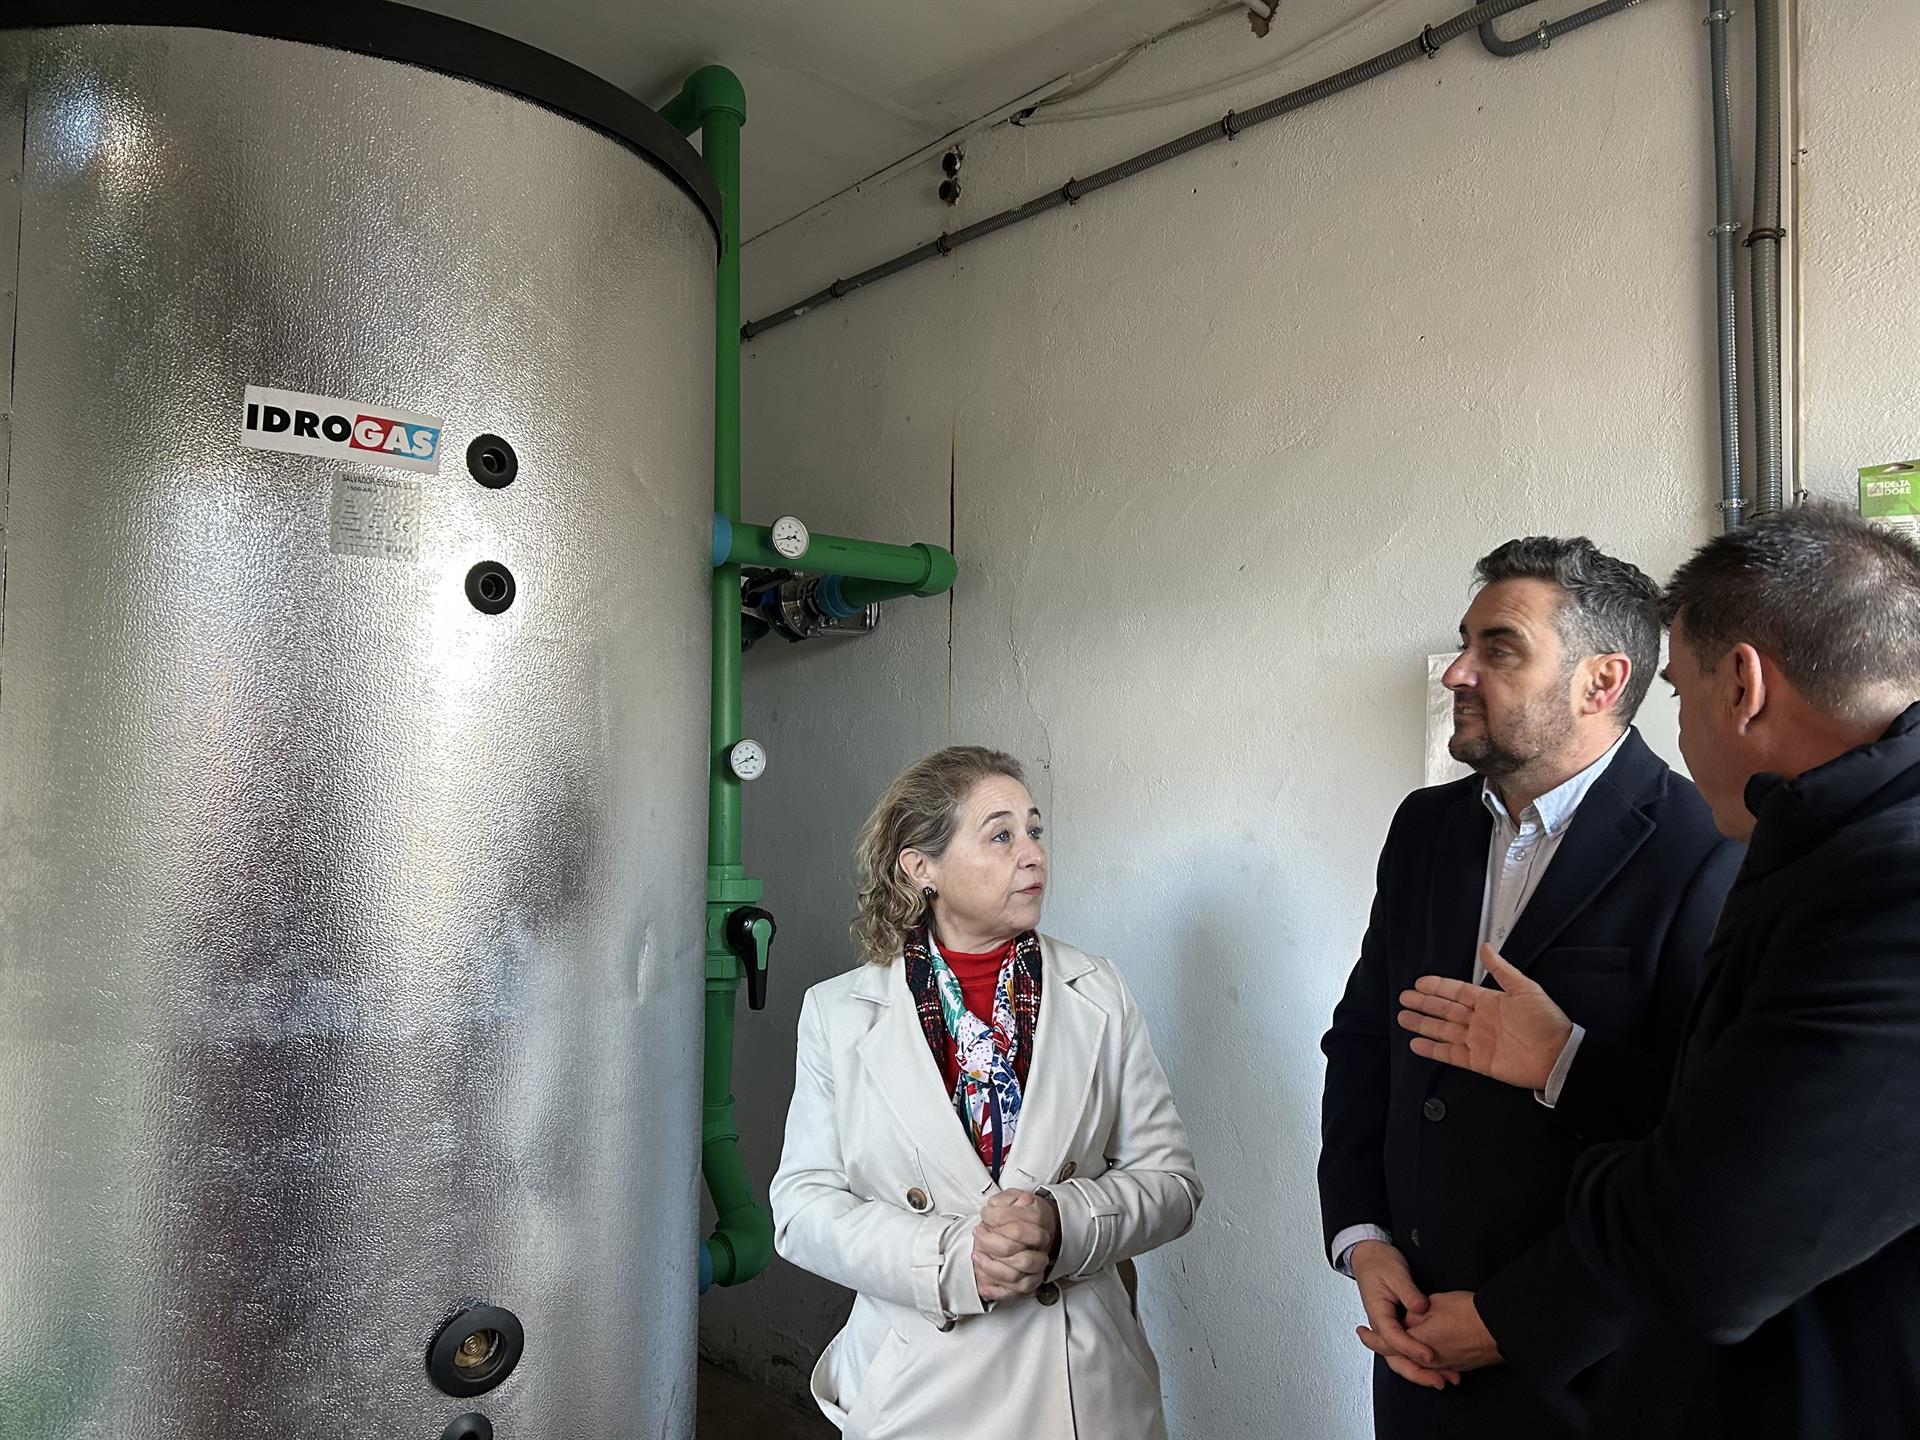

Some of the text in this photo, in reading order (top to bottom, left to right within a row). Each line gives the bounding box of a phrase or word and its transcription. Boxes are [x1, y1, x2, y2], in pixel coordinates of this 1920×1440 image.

[246, 403, 436, 458] IDROGAS
[341, 473, 375, 486] SALVADOR
[376, 477, 402, 489] ESCODA
[1885, 480, 1911, 488] DELTA
[1885, 486, 1911, 495] DORE
